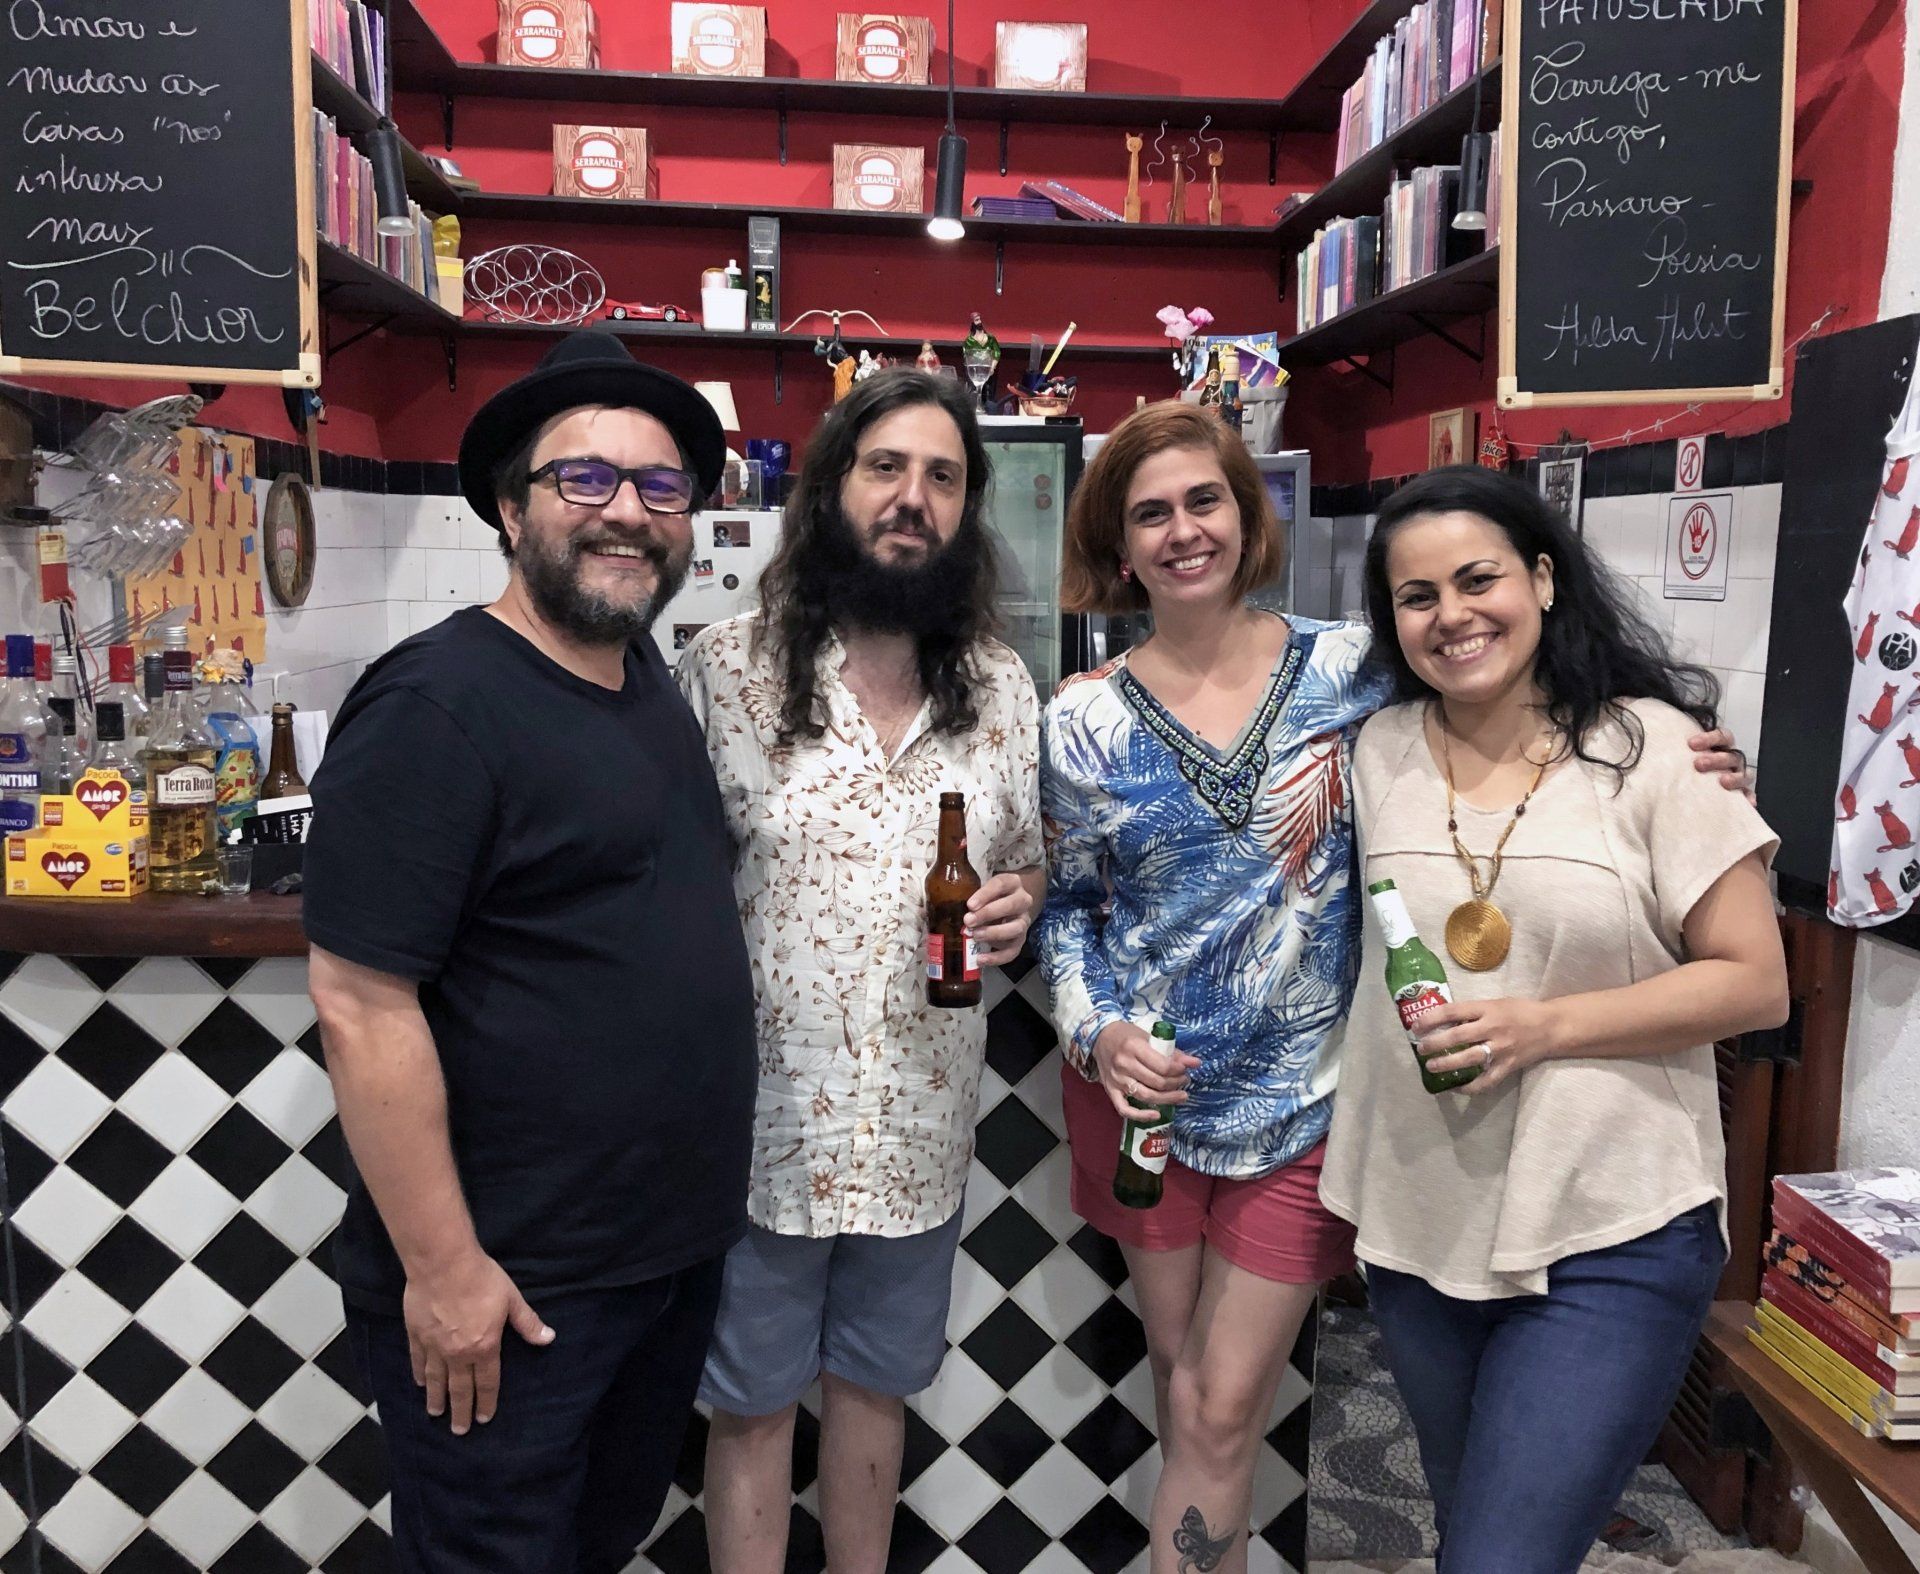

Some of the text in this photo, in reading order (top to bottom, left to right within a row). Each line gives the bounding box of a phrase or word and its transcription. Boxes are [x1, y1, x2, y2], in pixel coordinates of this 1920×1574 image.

[157, 20, 198, 37] e
[514, 26, 564, 39] SERRAMALTE
[857, 45, 906, 59] SERRAMALTE
[160, 73, 221, 97] as
[574, 157, 624, 170] SERRAMALTE
[854, 175, 902, 188] SERRAMALTE
[23, 276, 286, 346] Belchior
[163, 777, 214, 792] Terra Roxa
[81, 789, 121, 803] AMOR
[47, 860, 85, 874] AMOR
[1402, 996, 1439, 1015] STELLA
